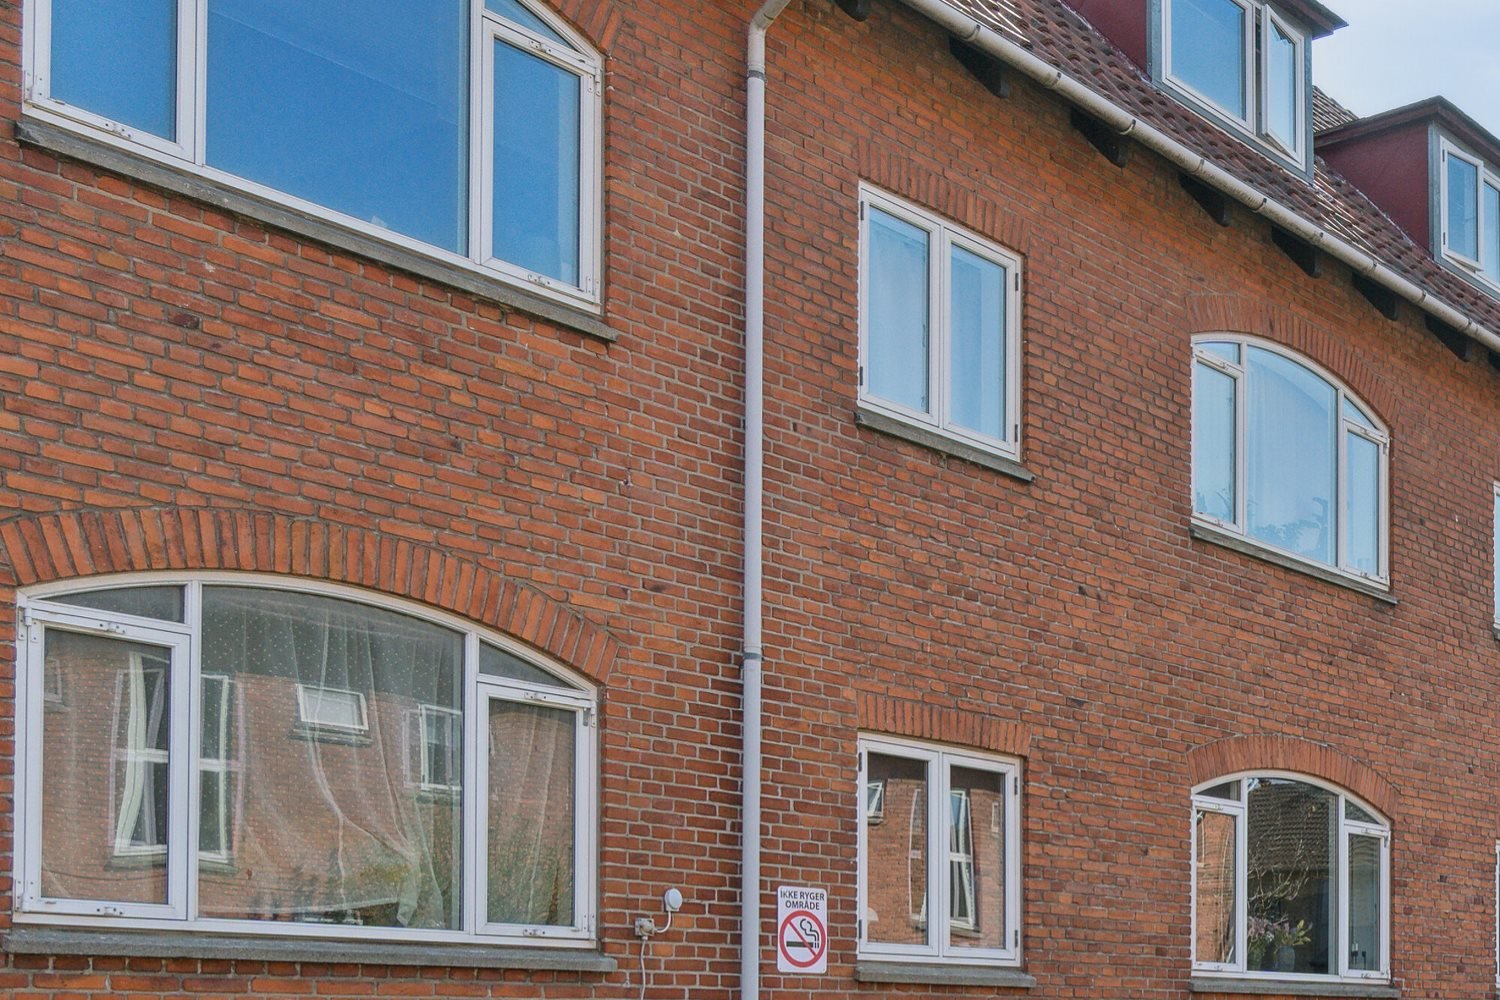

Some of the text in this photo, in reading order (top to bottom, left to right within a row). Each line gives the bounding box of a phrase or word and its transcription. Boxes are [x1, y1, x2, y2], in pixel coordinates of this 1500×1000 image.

[780, 890, 825, 900] IKKE RYGER
[785, 899, 820, 910] OMRÅDE
